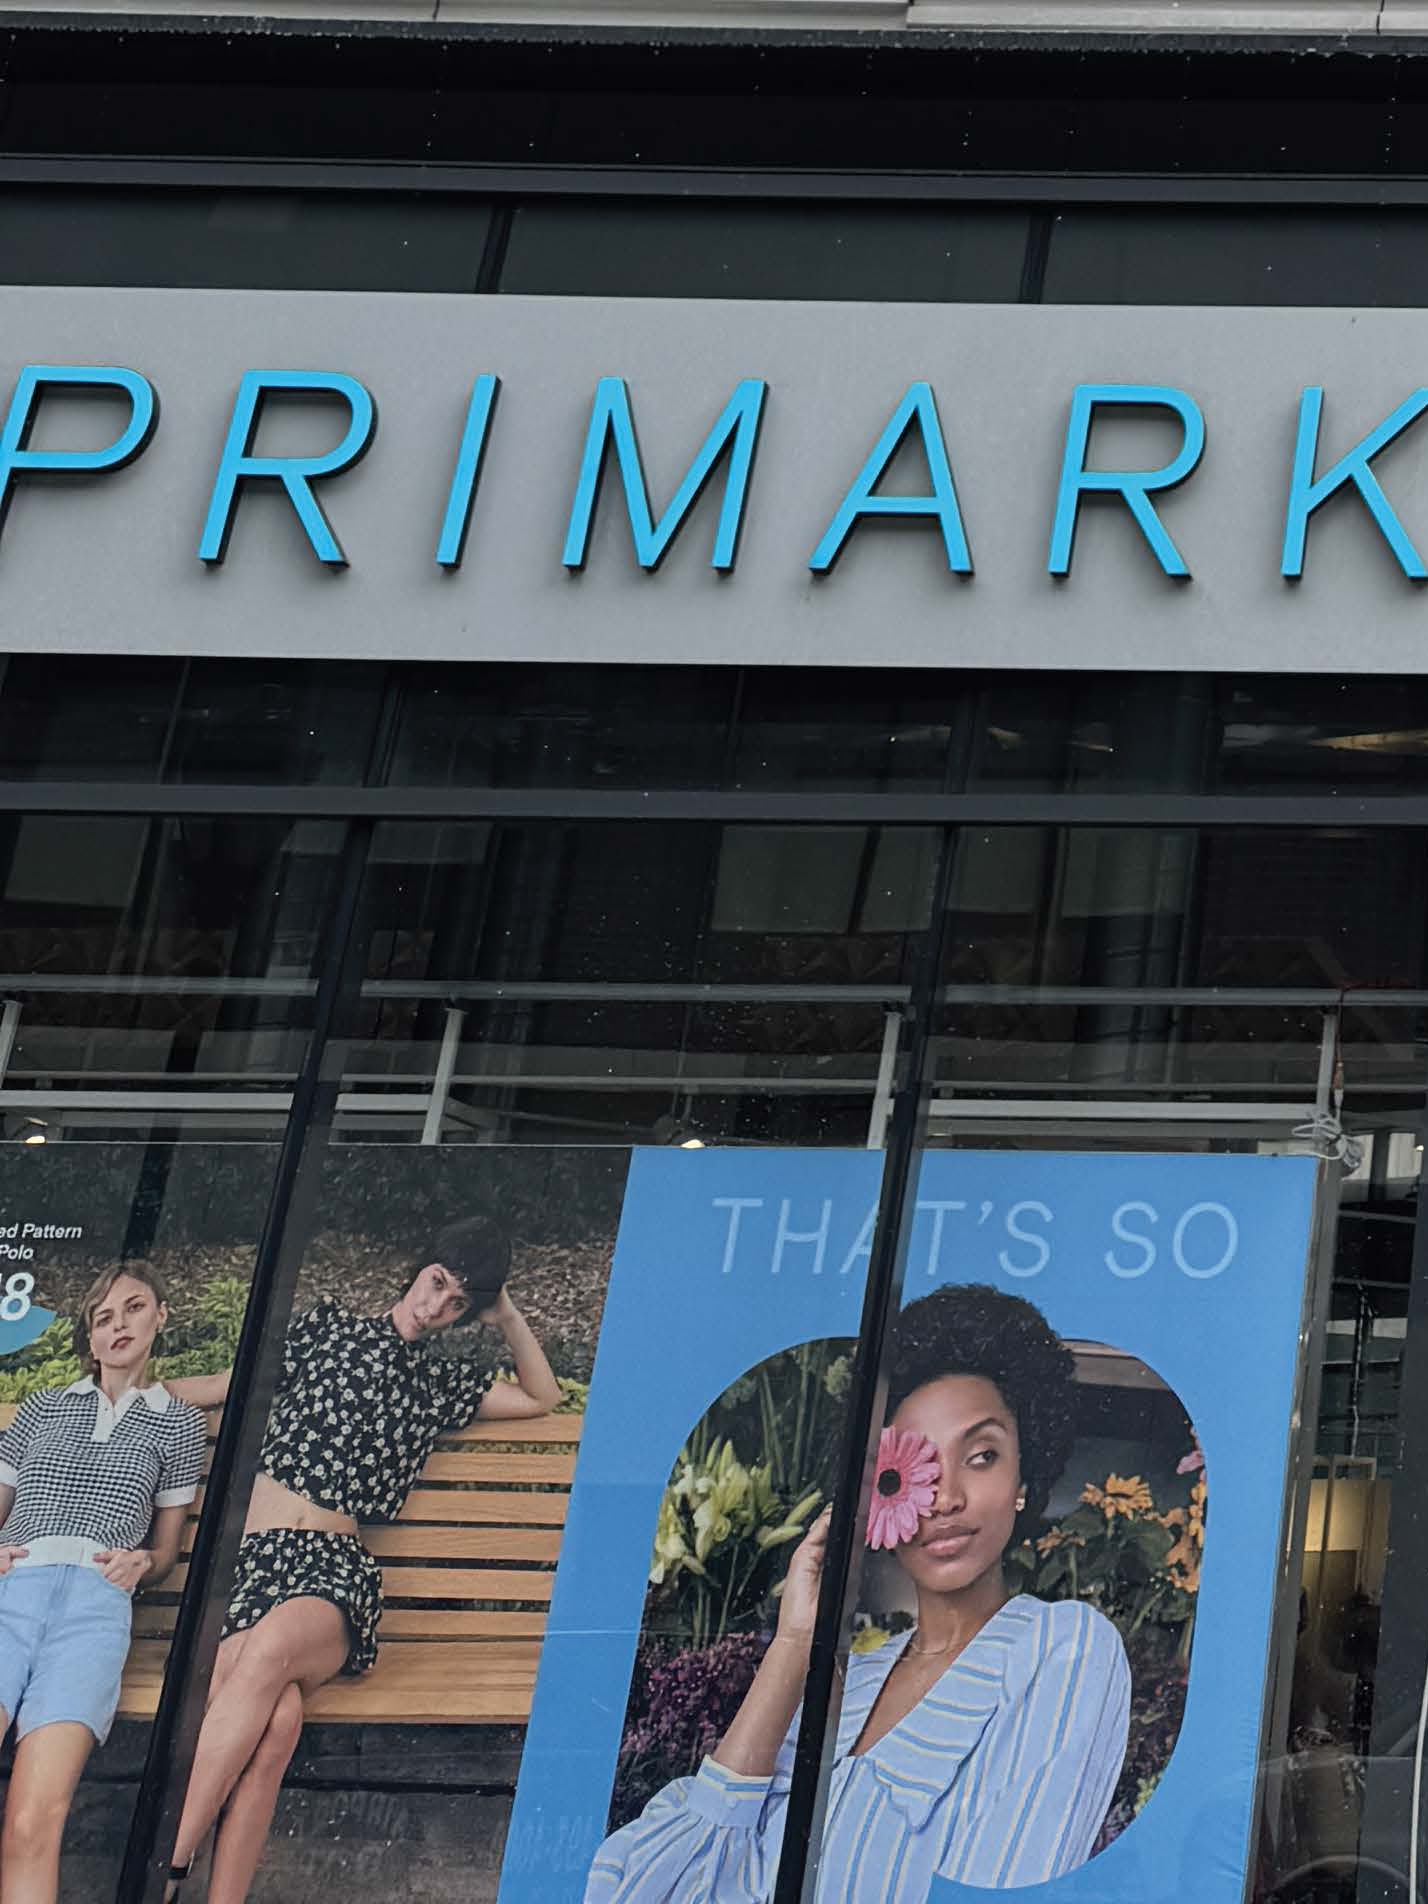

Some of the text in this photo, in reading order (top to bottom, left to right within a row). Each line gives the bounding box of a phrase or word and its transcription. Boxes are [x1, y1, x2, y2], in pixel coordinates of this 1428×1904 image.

[22, 1223, 83, 1239] Pattern
[1103, 1200, 1239, 1280] SO
[0, 1244, 34, 1260] Polo
